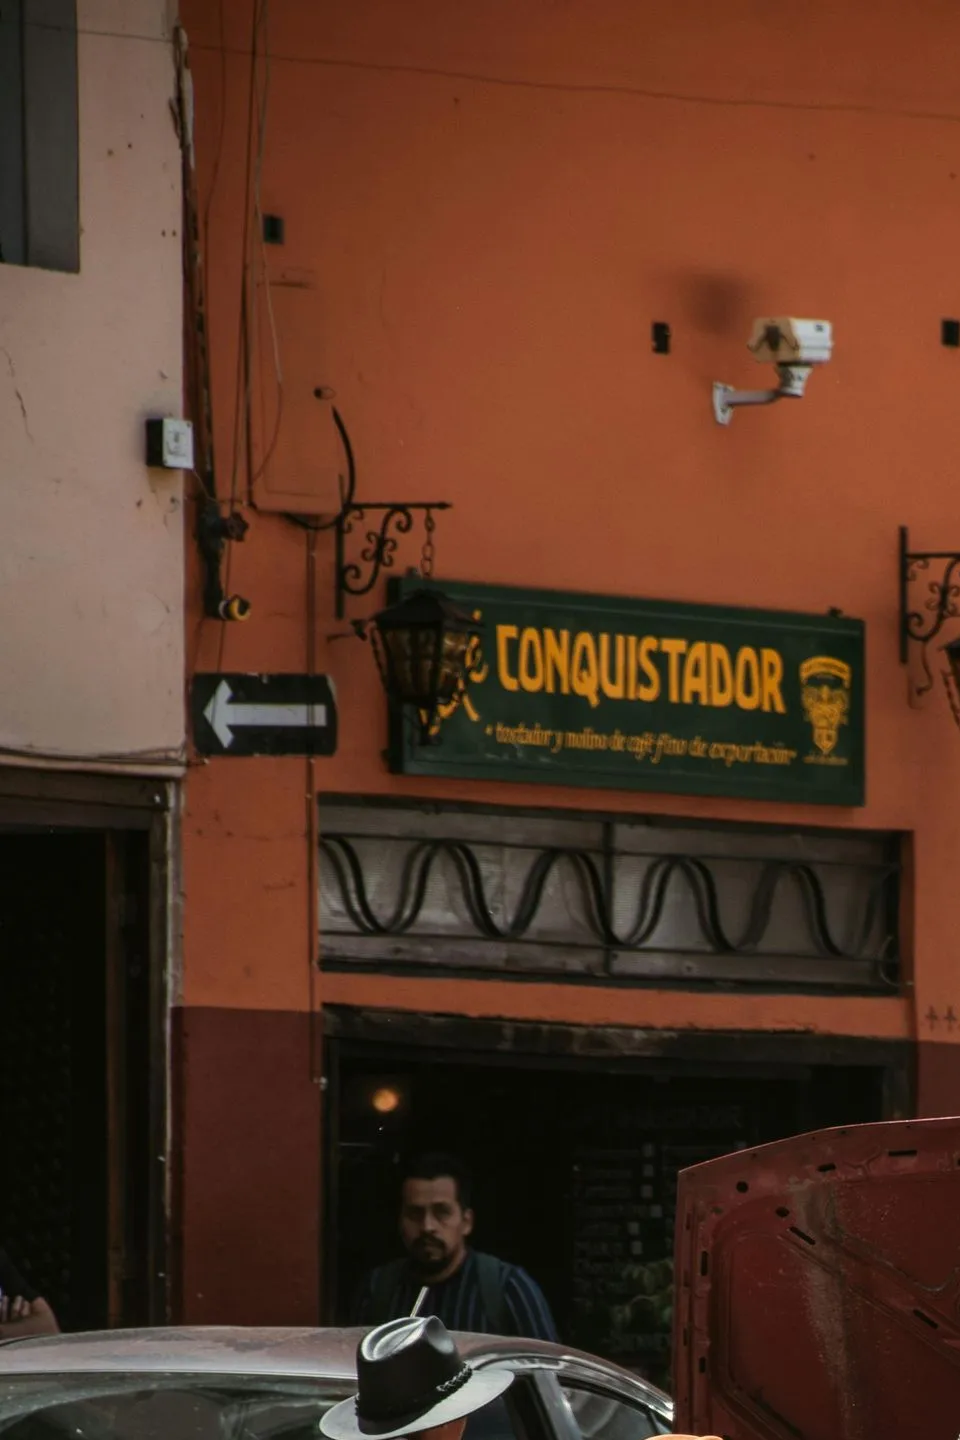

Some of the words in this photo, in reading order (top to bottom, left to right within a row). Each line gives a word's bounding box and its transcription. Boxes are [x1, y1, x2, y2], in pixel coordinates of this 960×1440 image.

[496, 624, 787, 714] CONQUISTADOR
[550, 731, 562, 754] y
[565, 727, 608, 752] molino
